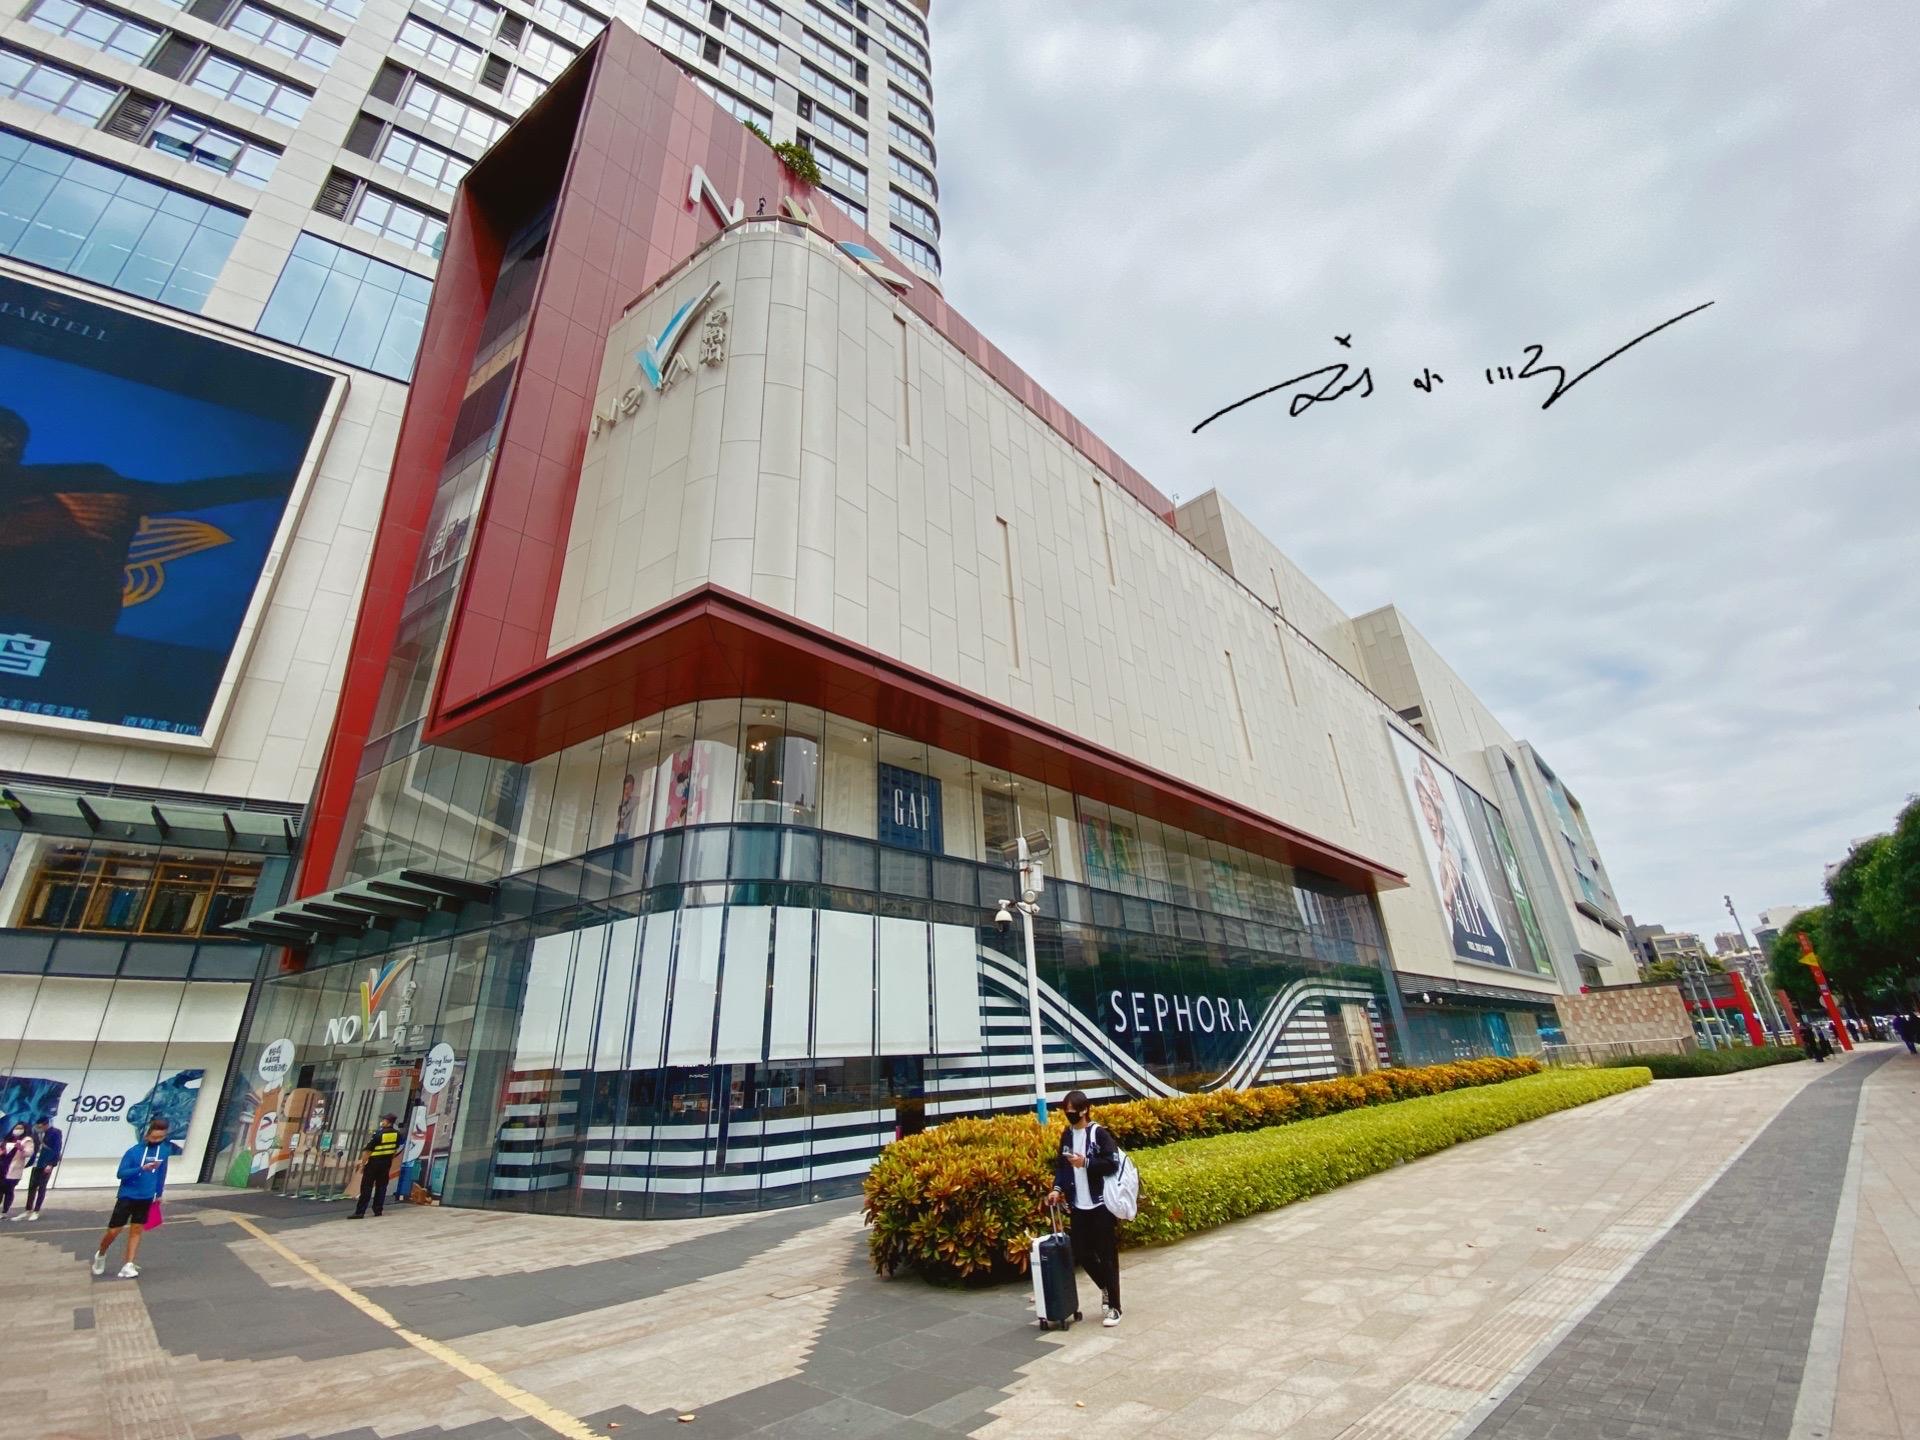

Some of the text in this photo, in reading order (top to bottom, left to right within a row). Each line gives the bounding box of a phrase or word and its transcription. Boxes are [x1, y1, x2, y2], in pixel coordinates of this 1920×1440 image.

[894, 788, 930, 831] GAP
[324, 955, 416, 1046] NOVA
[1110, 990, 1253, 1033] SEPHORA
[66, 1114, 120, 1123] Gap Jeans
[72, 1095, 126, 1113] 1969
